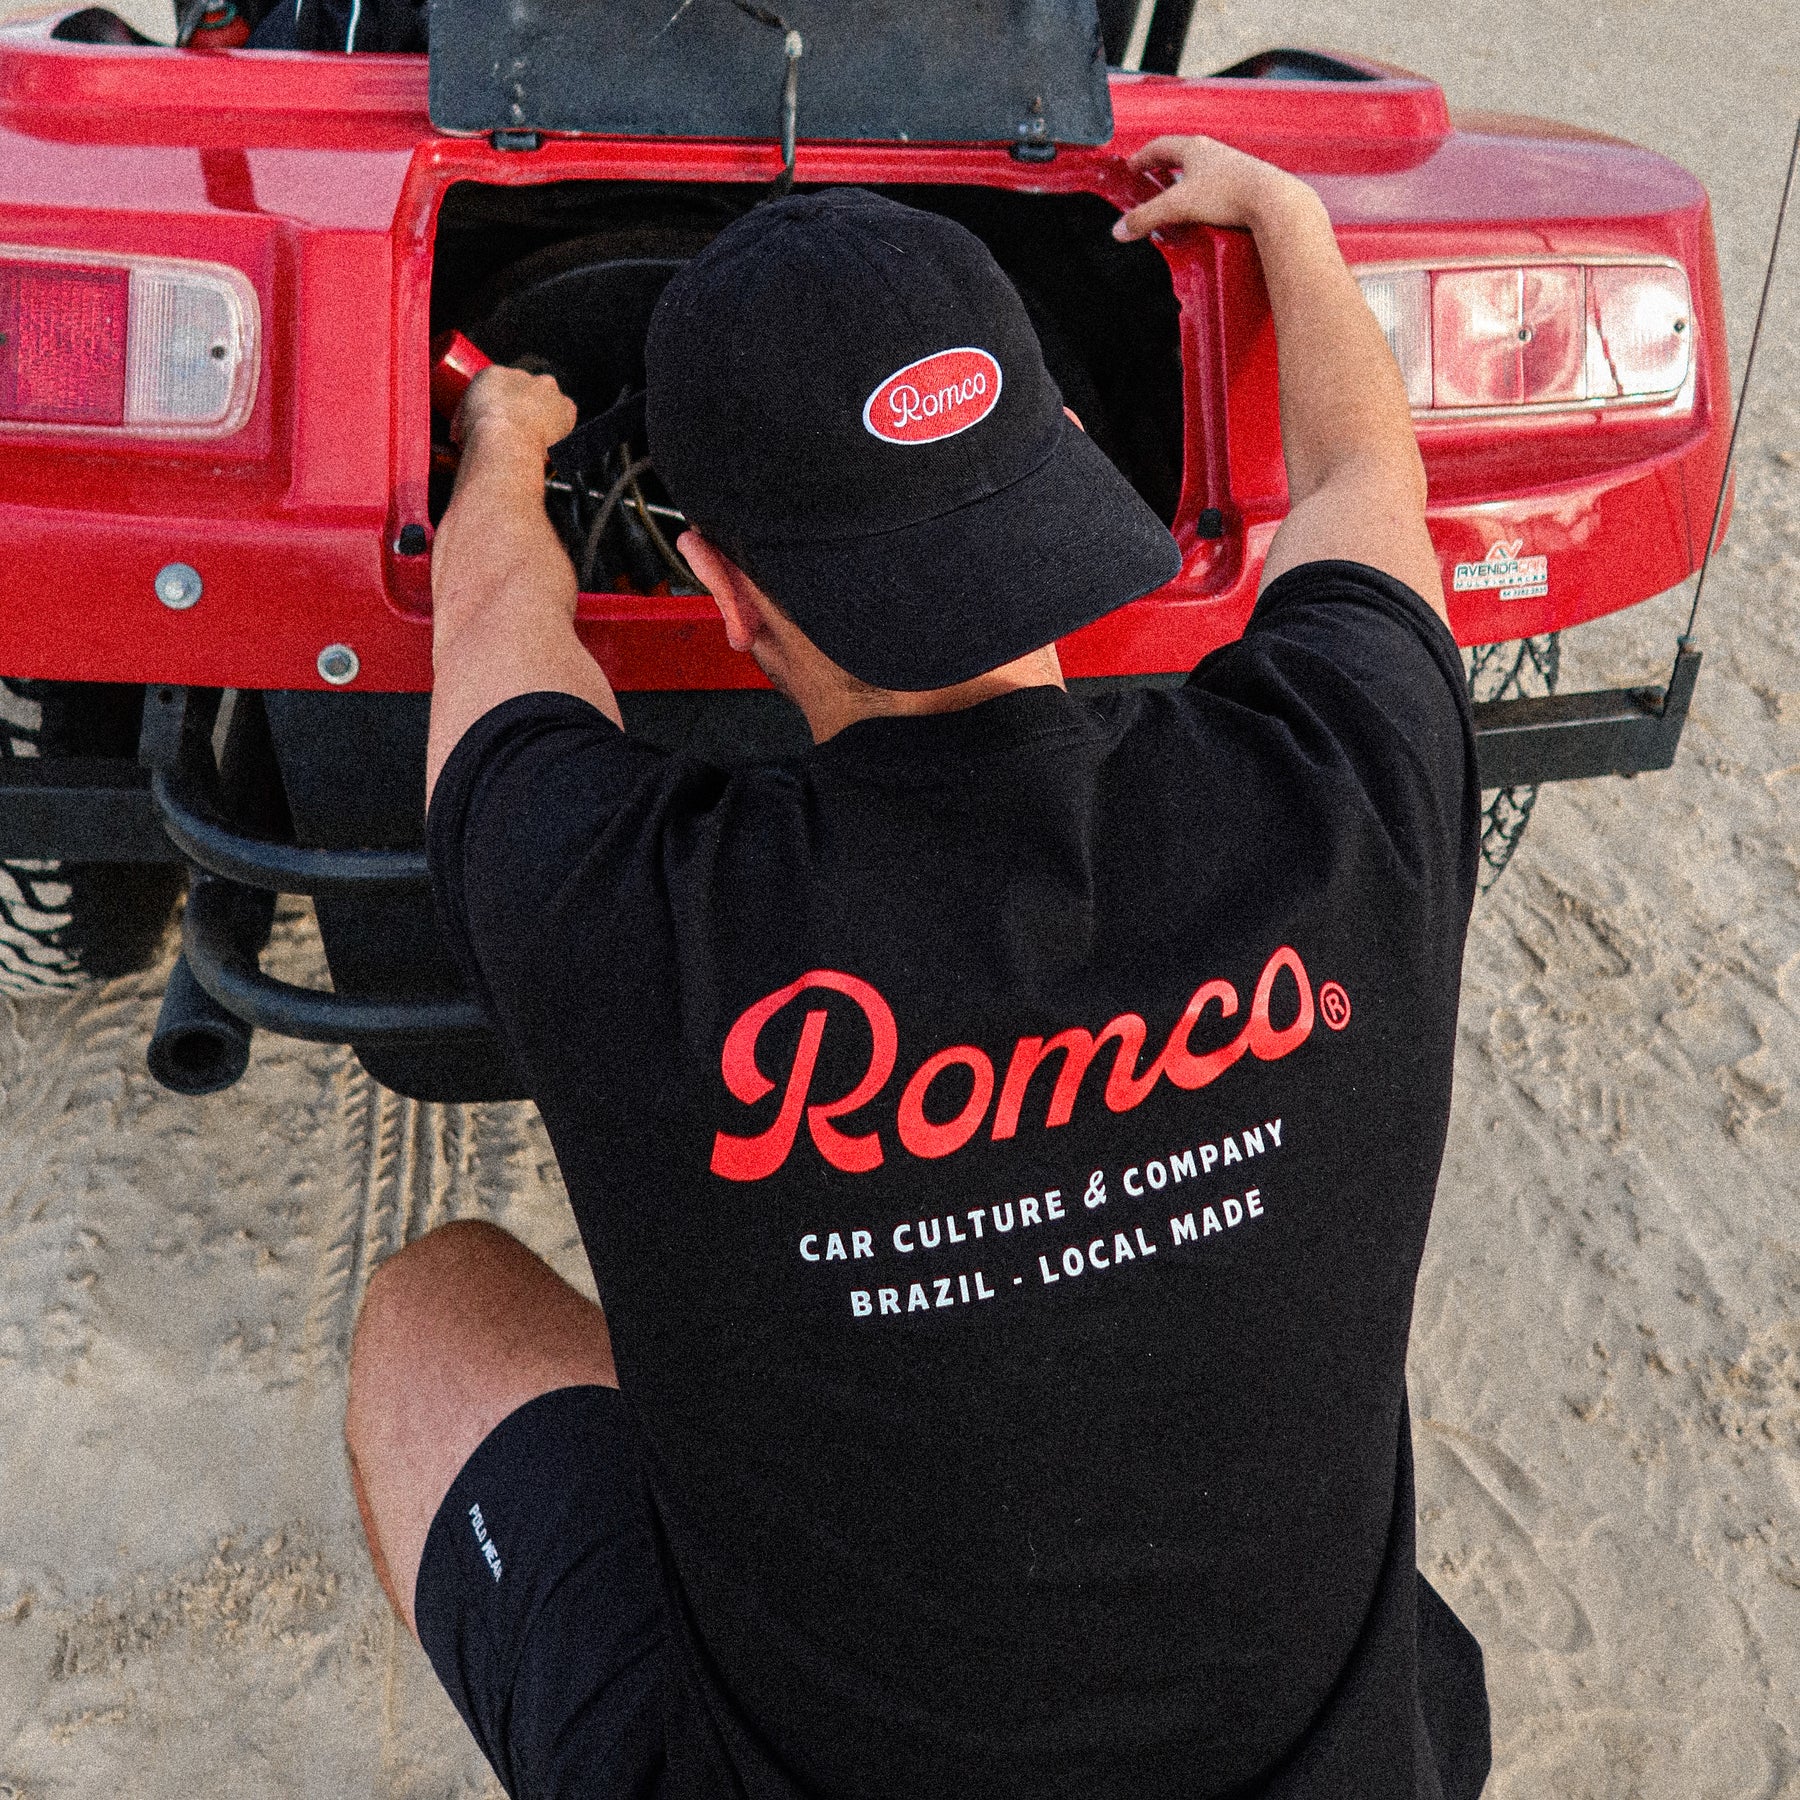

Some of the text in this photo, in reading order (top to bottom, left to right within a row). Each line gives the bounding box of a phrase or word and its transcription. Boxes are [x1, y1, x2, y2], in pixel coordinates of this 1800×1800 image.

[889, 372, 986, 428] Romco
[799, 1118, 1282, 1262] CAR CULTURE & COMPANY
[850, 1271, 995, 1317] BRAZIL
[1038, 1212, 1157, 1285] LOCAL
[1169, 1188, 1265, 1246] MADE
[468, 1502, 503, 1583] POLO WEAR
